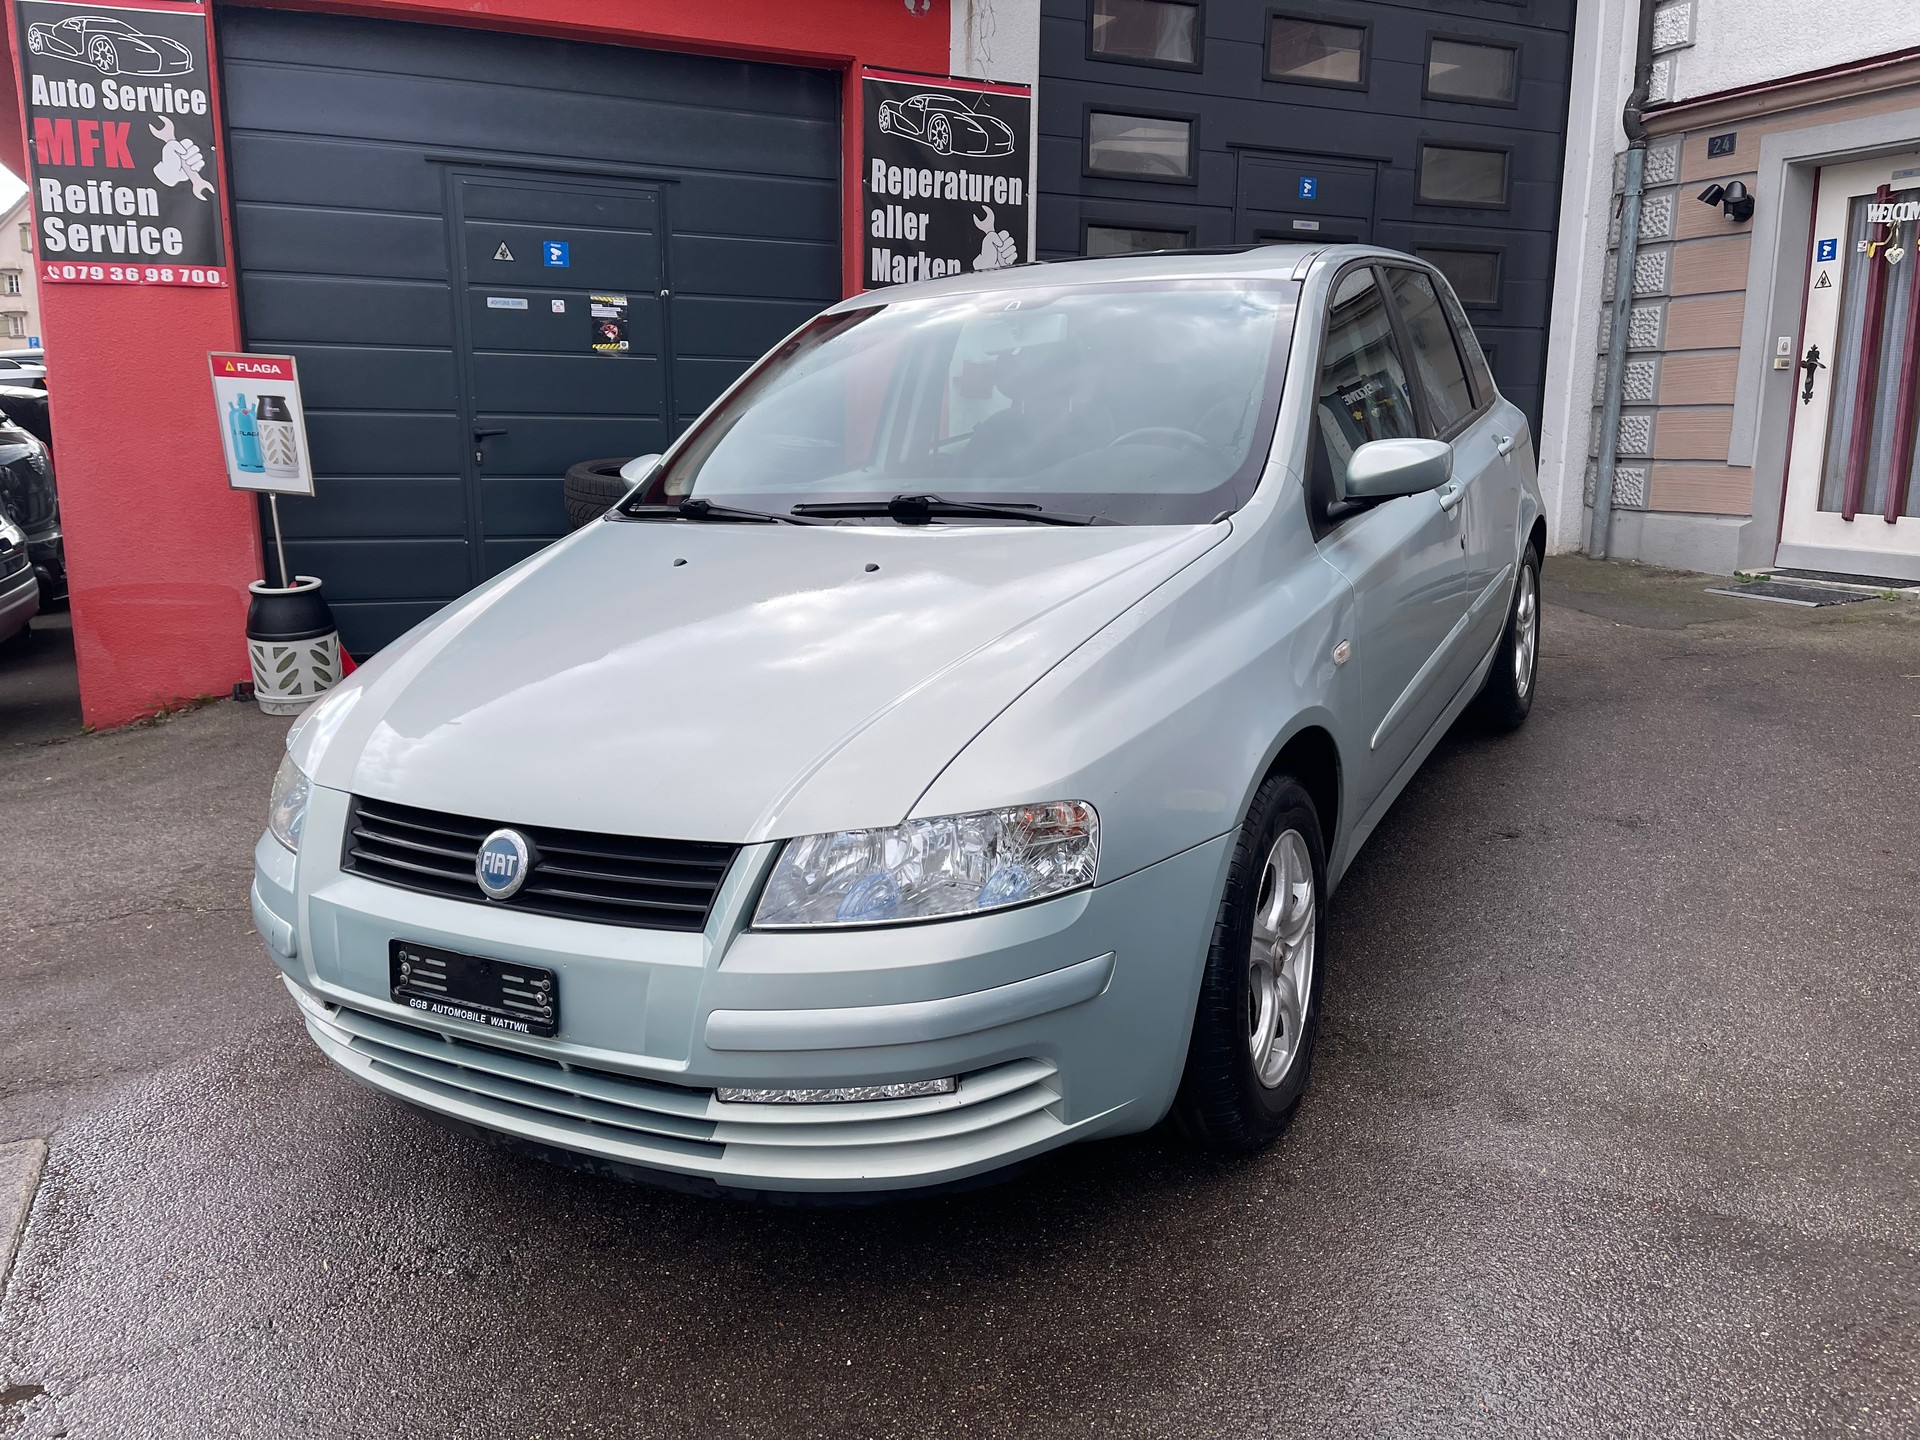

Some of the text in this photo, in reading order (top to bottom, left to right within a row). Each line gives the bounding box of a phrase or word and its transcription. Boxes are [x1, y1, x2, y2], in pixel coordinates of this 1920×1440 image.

[31, 74, 207, 115] Auto Service
[33, 117, 136, 169] MFK
[1713, 137, 1730, 154] 24
[39, 178, 160, 217] Reifen
[871, 158, 1023, 206] Reperaturen
[43, 216, 183, 256] Service
[871, 204, 930, 241] aller
[62, 265, 220, 284] 079 36 98 700
[871, 247, 961, 284] Marken
[236, 363, 282, 374] FLAGA
[481, 851, 518, 877] FIAT
[409, 998, 531, 1034] GGB AUTOMOBILE WATTWIL
